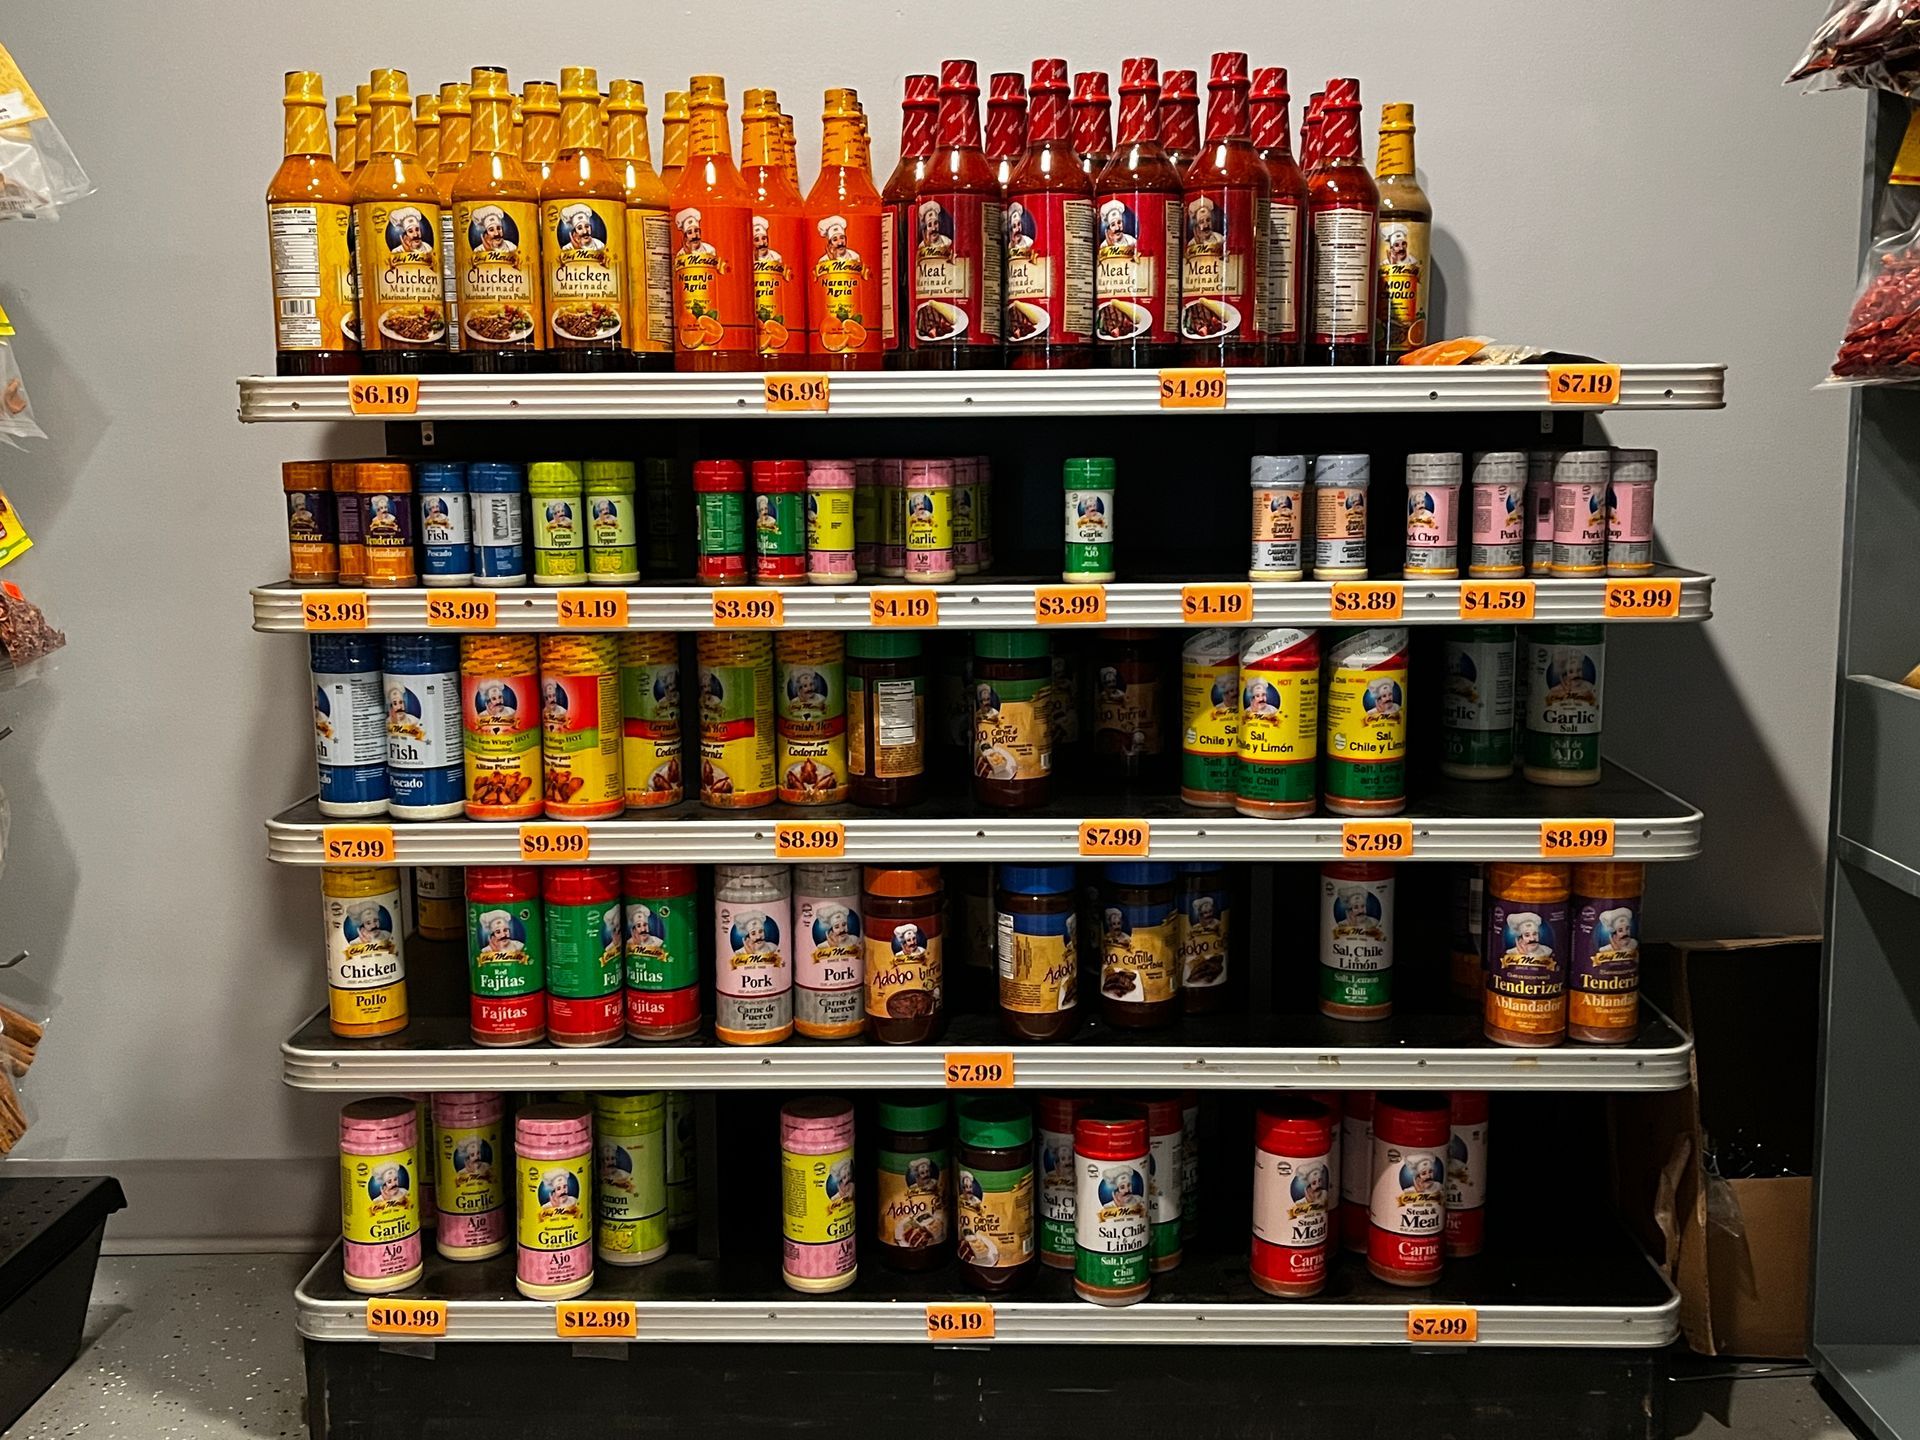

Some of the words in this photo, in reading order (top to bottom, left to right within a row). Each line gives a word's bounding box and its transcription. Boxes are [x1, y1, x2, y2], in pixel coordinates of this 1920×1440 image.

[688, 255, 718, 265] Merito
[556, 266, 610, 282] Chicken
[754, 263, 784, 273] Merito
[832, 262, 862, 273] Merito
[919, 264, 946, 277] Meat
[1101, 263, 1130, 276] Meat
[1188, 262, 1218, 275] Meat
[384, 269, 437, 285] Chicken
[468, 268, 522, 284] Chicken
[678, 274, 713, 282] Naranja
[390, 285, 436, 293] Marinade
[472, 284, 520, 292] Marinade
[561, 282, 607, 290] Marinade
[683, 282, 707, 292] Agria
[822, 279, 857, 287] Naranja
[1385, 281, 1411, 291] MOJO
[827, 288, 852, 296] Agria
[1161, 379, 1224, 398] $4.99
[1556, 374, 1613, 393] $7.19
[352, 385, 409, 404] $6.19
[767, 380, 826, 401] $6.99
[365, 536, 405, 545] Tenderizer
[427, 530, 449, 540] Fish
[909, 534, 936, 544] Garlic
[1418, 533, 1439, 543] Chop
[916, 554, 928, 563] Ajo
[1185, 595, 1241, 613] $4.19
[1335, 592, 1395, 610] $3.89
[1465, 592, 1525, 609] $4.59
[1610, 590, 1671, 608] $3.99
[306, 604, 365, 621] $3.99
[429, 601, 488, 619] $3.99
[561, 600, 617, 618] $4.19
[715, 601, 774, 618] $3.99
[874, 599, 929, 617] $4.19
[1040, 597, 1098, 615] $3.99
[1543, 710, 1594, 724] Garlic
[1560, 724, 1578, 732] Salt
[1200, 735, 1224, 745] Chile
[1228, 737, 1234, 746] y
[1250, 731, 1267, 742] Sal,
[1377, 732, 1393, 741] Sal,
[390, 743, 418, 759] Fish
[788, 747, 827, 757] Codorniz
[1253, 745, 1258, 753] y
[1261, 739, 1293, 752] Limón
[1350, 742, 1376, 751] Chile
[1379, 745, 1384, 753] y
[1553, 749, 1584, 761] AJO
[1253, 767, 1286, 775] Lemon
[389, 775, 423, 788] Pescado
[1257, 777, 1279, 786] Chili
[1360, 776, 1379, 784] and
[524, 835, 583, 852] $9.99
[780, 831, 838, 848] $8.99
[1086, 829, 1141, 846] $7.99
[1346, 834, 1402, 851] $7.99
[1546, 829, 1607, 848] $8.99
[330, 841, 384, 857] $7.99
[495, 953, 523, 961] Merito
[1333, 944, 1352, 957] Sal,
[1355, 946, 1383, 957] Chile
[1340, 958, 1377, 969] Limón
[340, 962, 396, 979] Chicken
[824, 968, 855, 980] Pork
[481, 975, 524, 990] Fajitas
[742, 975, 772, 988] Pork
[874, 969, 913, 988] Adobo
[1493, 975, 1563, 994] Tenderizer
[1346, 987, 1366, 995] Chili
[356, 994, 386, 1006] Pollo
[819, 999, 844, 1007] Carne
[1495, 996, 1560, 1012] Ablandador
[482, 1006, 527, 1022] Fajitas
[738, 1005, 761, 1014] Carne
[763, 1005, 775, 1013] de
[824, 1005, 855, 1013] Puerco
[948, 1065, 1002, 1082] $7.99
[456, 1195, 494, 1210] Garlic
[887, 1202, 926, 1218] Adobo
[1406, 1208, 1429, 1216] Steak
[467, 1217, 486, 1231] Ajo
[1298, 1218, 1317, 1227] Steak
[1401, 1214, 1439, 1228] Meat
[370, 1220, 410, 1238] Garlic
[1099, 1227, 1120, 1240] Sal,
[1122, 1224, 1146, 1237] Chile
[538, 1229, 578, 1245] Garlic
[1107, 1239, 1142, 1251] Limón
[383, 1245, 402, 1259] Ajo
[550, 1254, 570, 1267] Ajo
[1101, 1256, 1119, 1266] Salt,
[1121, 1255, 1144, 1265] Lemon
[1114, 1268, 1133, 1277] Chili
[372, 1309, 439, 1327] $10.99
[565, 1311, 629, 1328] $12.99
[928, 1313, 981, 1331] $6.19
[1413, 1319, 1467, 1335] $7.99
